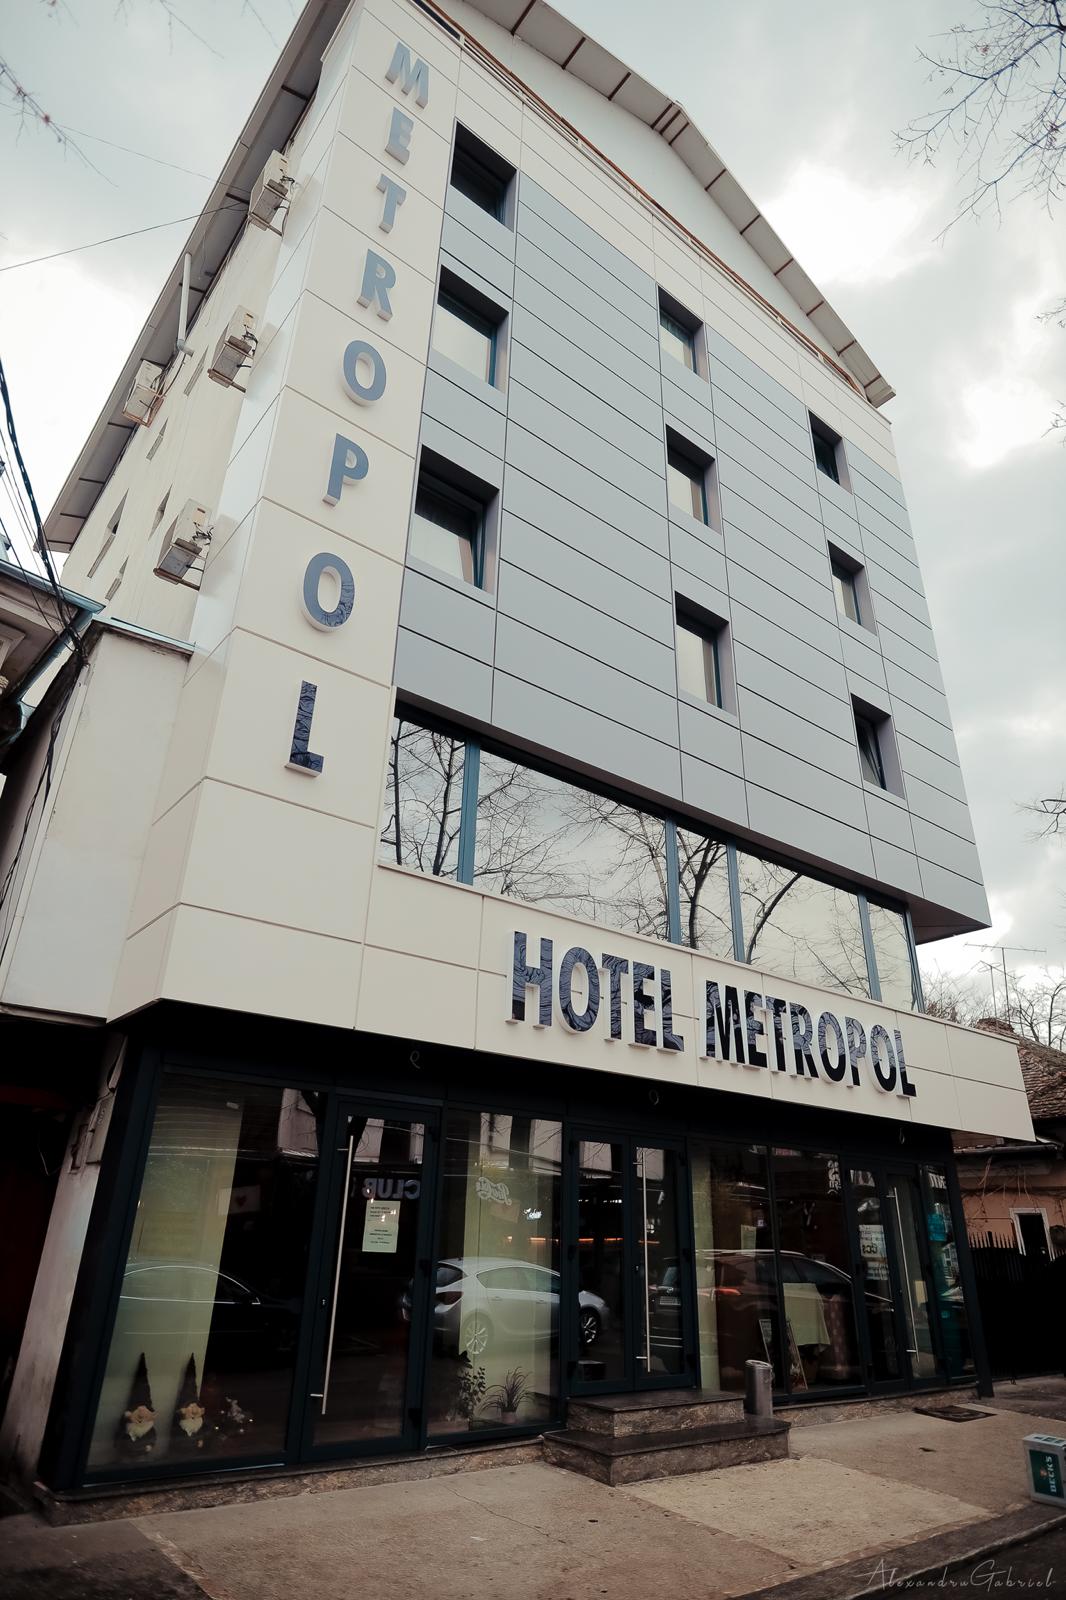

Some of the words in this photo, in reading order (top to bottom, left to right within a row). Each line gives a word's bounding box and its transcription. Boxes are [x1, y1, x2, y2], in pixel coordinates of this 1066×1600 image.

[285, 41, 430, 777] METROPOL
[507, 931, 685, 1053] HOTEL
[703, 979, 917, 1098] METROPOL
